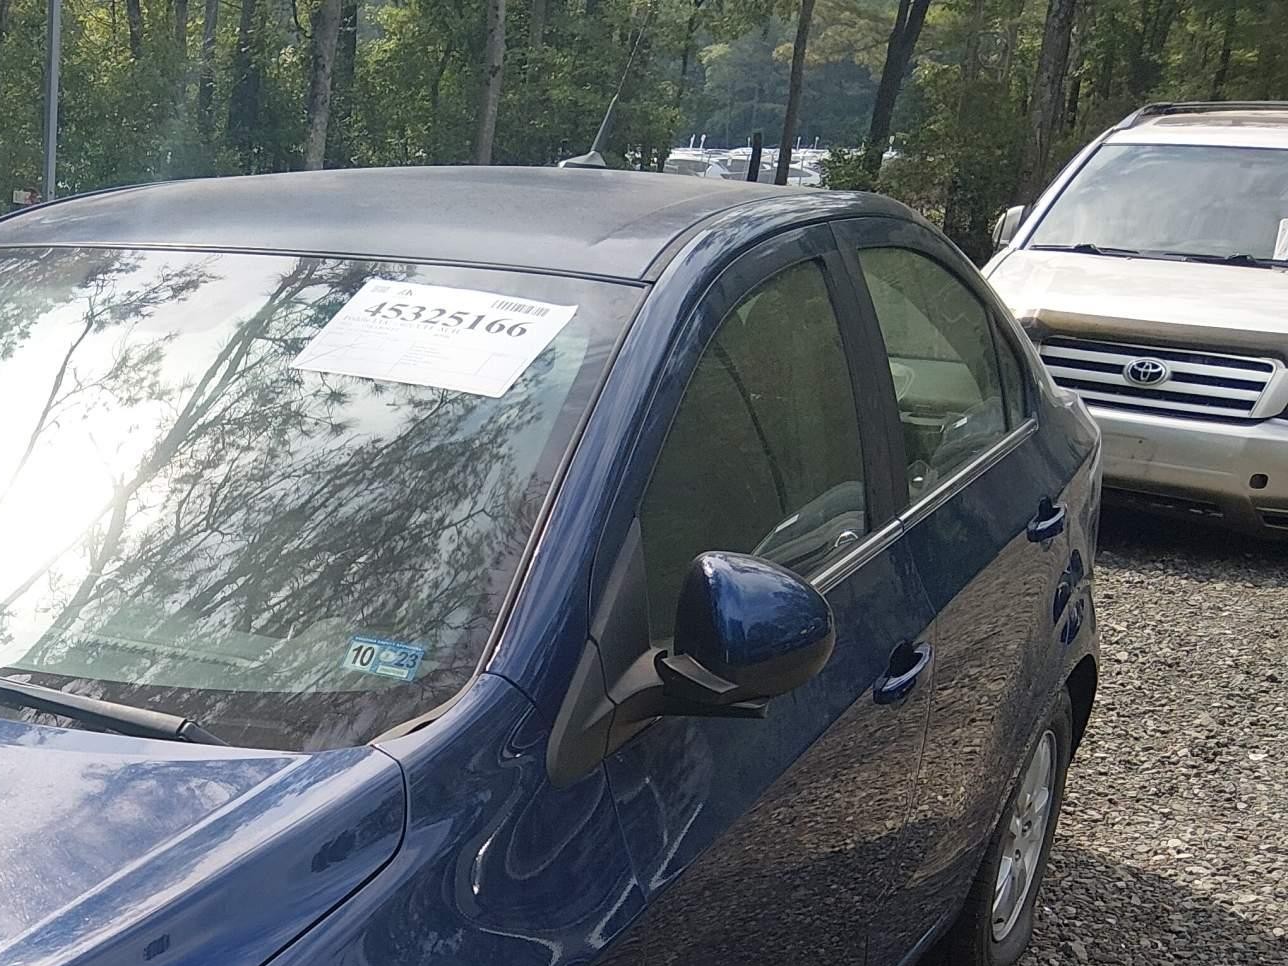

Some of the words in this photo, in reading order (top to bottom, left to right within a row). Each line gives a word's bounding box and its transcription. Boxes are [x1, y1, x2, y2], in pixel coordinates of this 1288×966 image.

[363, 301, 535, 338] 45325166
[351, 644, 375, 667] 10
[394, 652, 418, 668] 23
